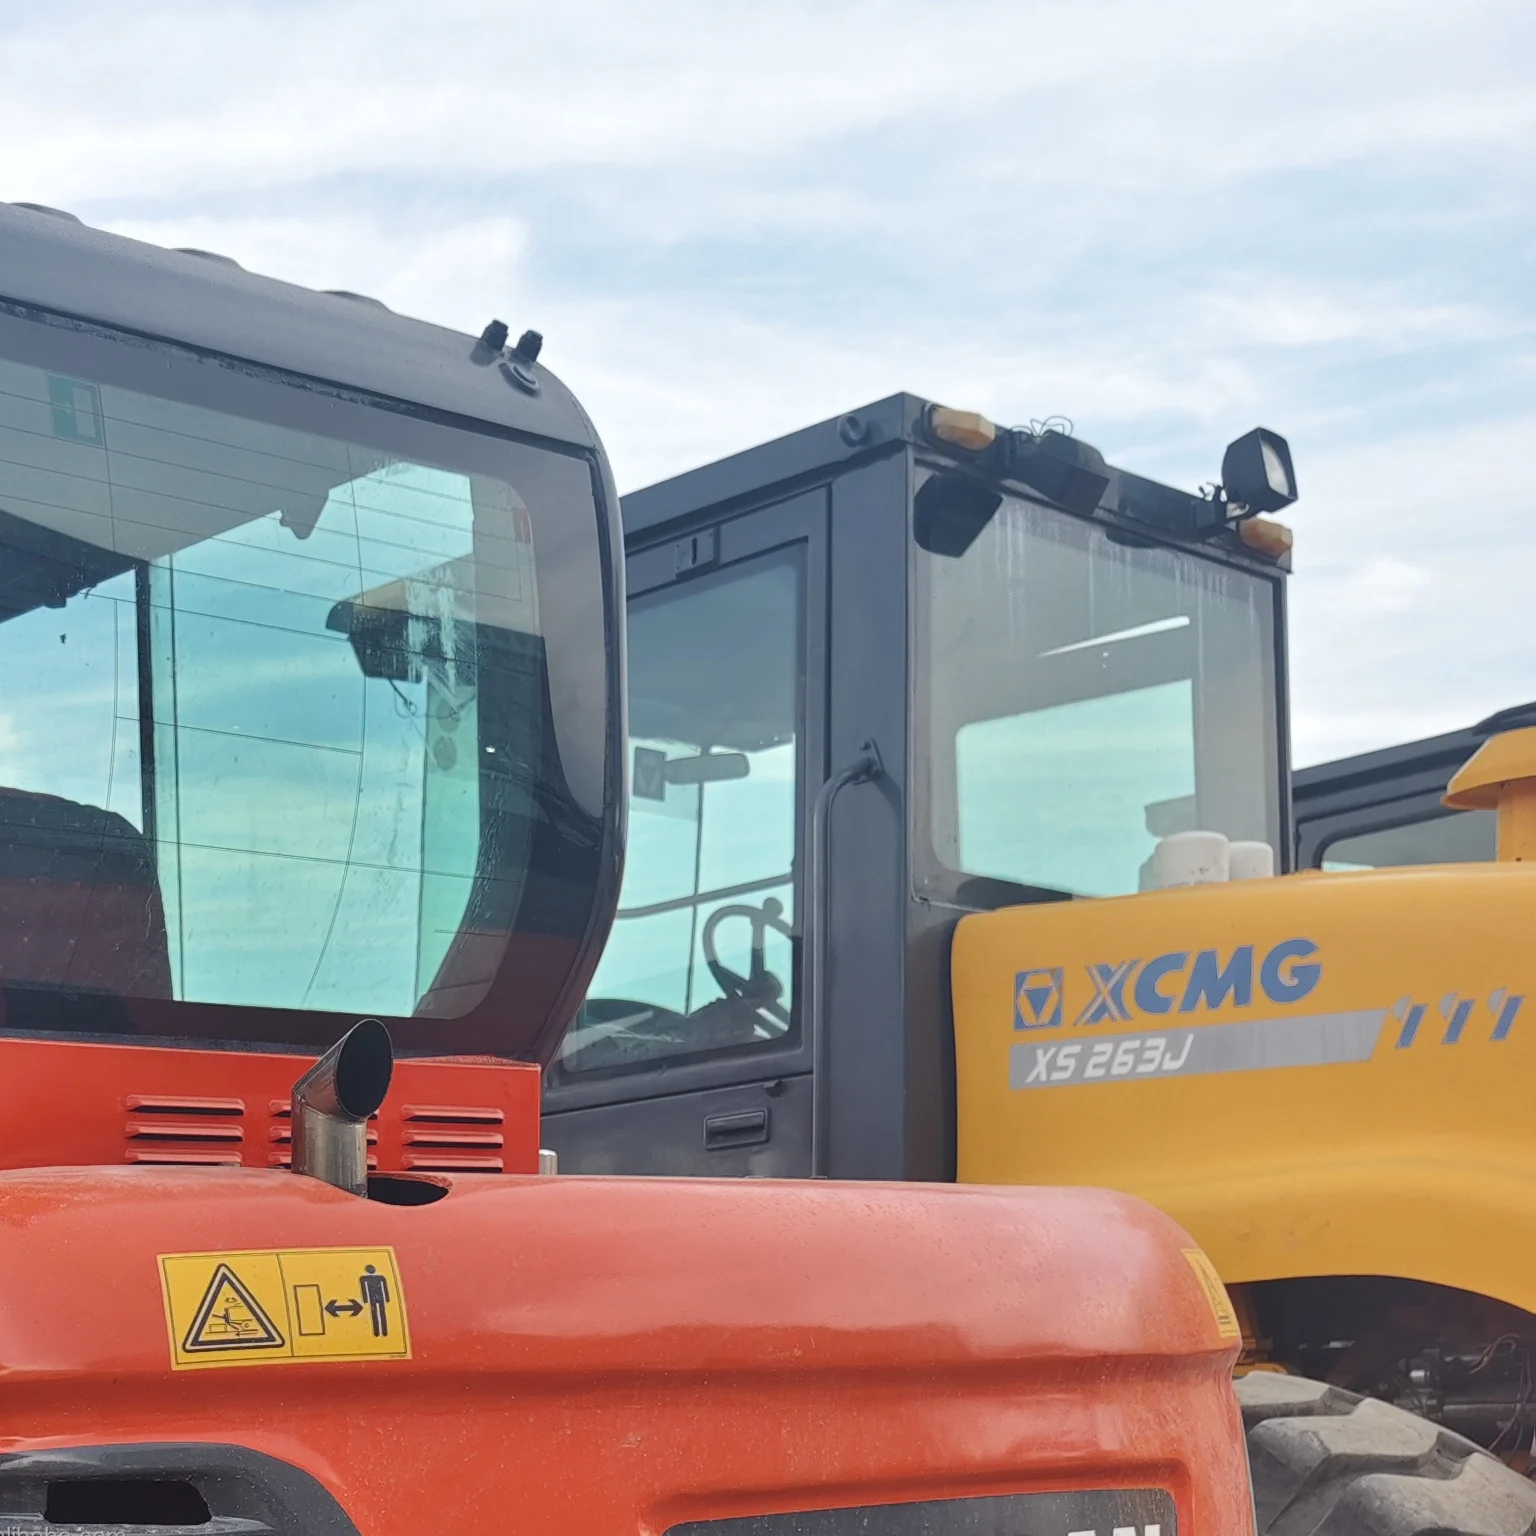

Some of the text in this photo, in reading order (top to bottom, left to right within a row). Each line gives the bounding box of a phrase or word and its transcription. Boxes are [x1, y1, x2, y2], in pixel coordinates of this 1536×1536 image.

[1073, 938, 1322, 1027] XCMG
[1025, 1033, 1195, 1084] XS 263J
